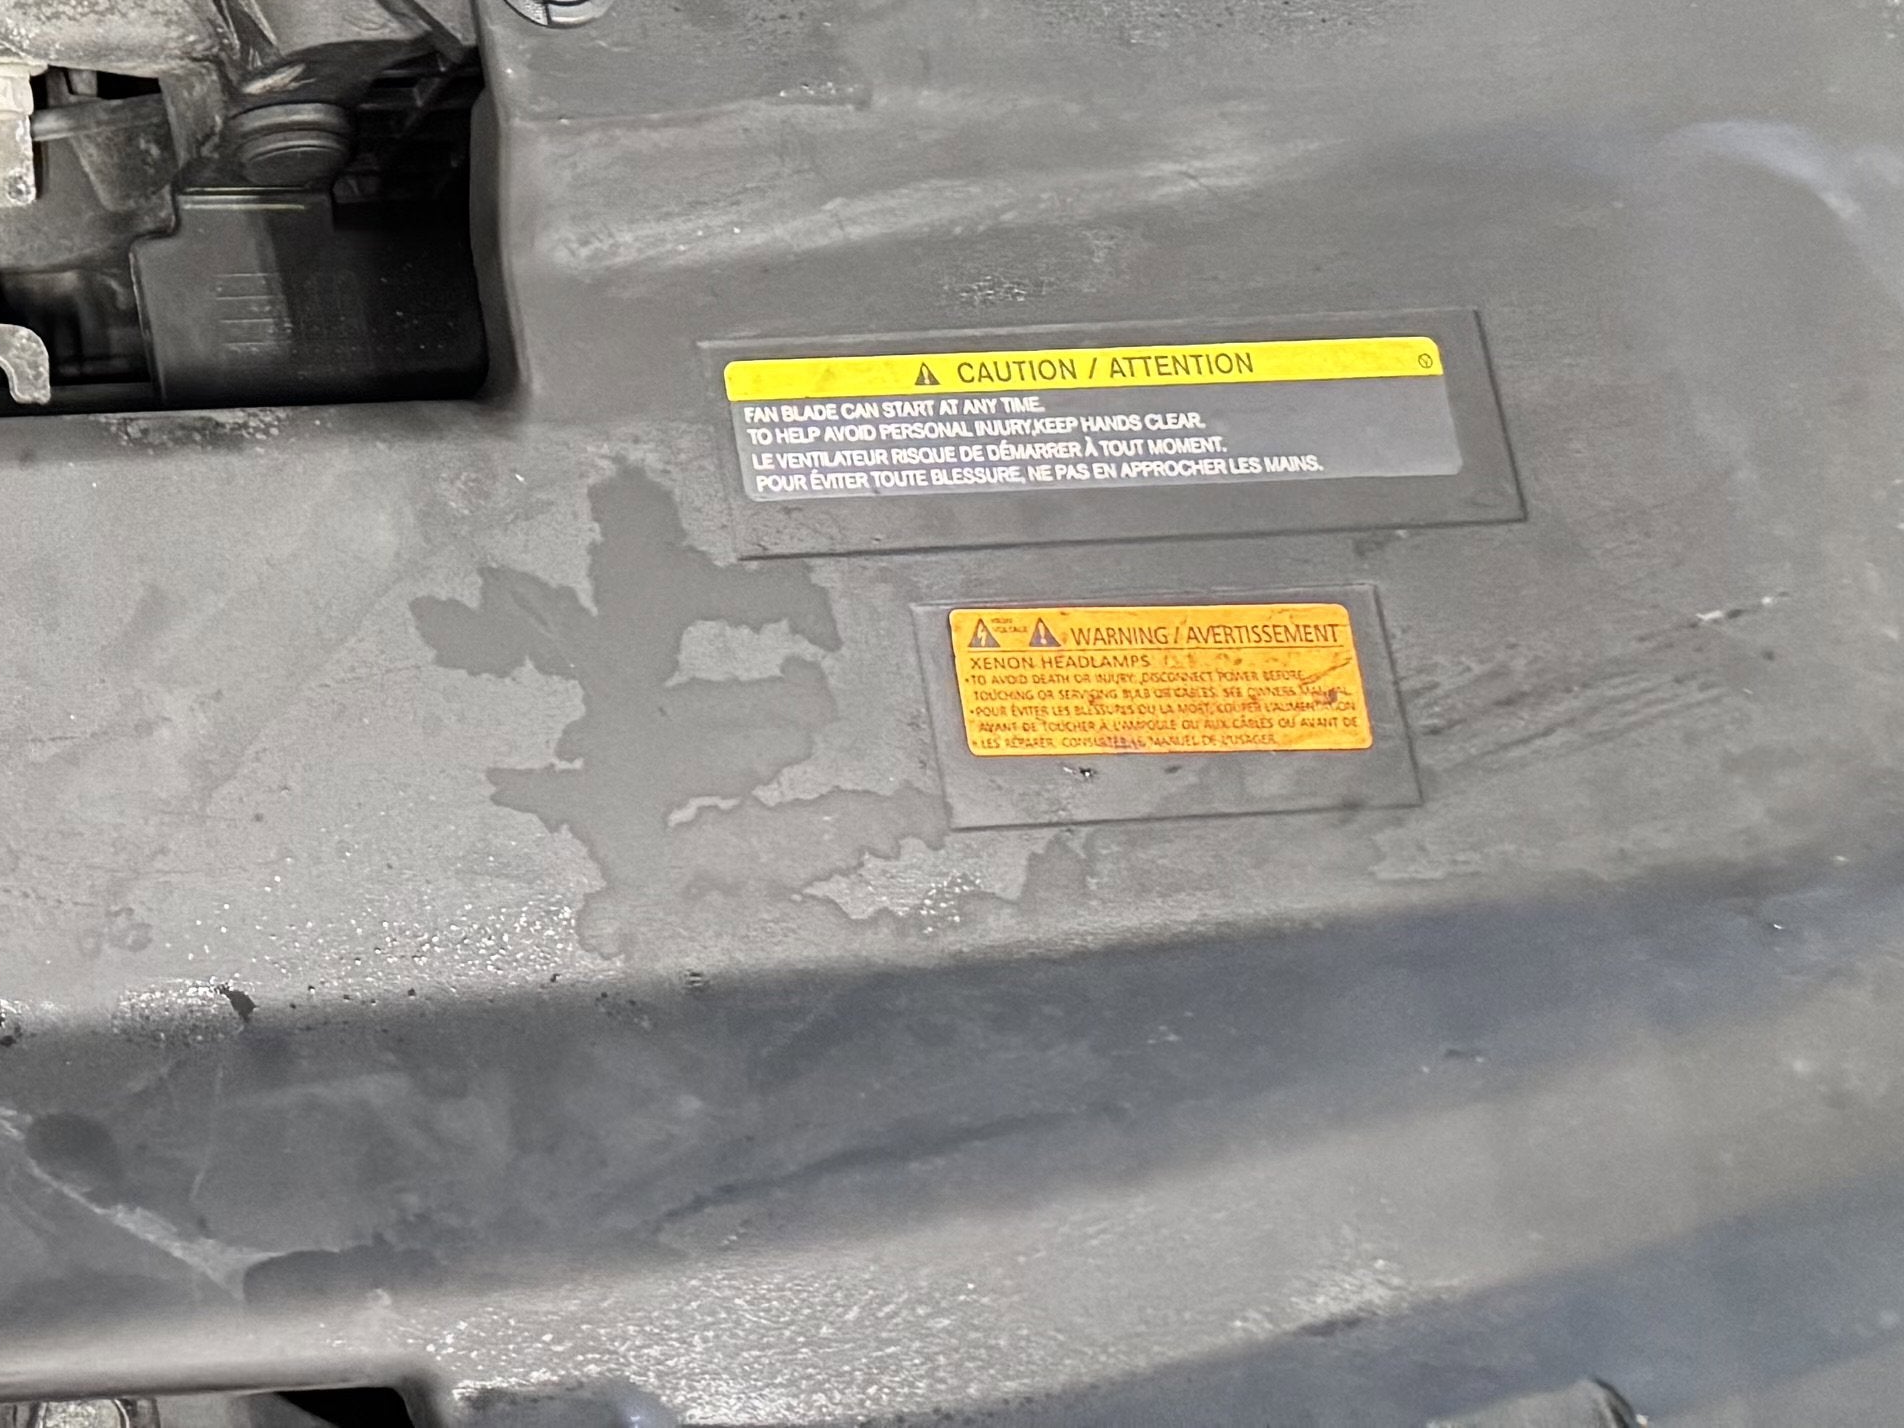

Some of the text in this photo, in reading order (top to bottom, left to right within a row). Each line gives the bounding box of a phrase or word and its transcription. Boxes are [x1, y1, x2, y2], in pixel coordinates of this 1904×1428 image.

[957, 352, 1254, 382] CAUTION / ATTENTION
[744, 396, 1045, 423] FAN BLADE CAN START AT ANY TIME.
[747, 429, 773, 444] TO
[776, 427, 820, 443] HELP
[824, 425, 877, 442] AVOID
[880, 421, 974, 439] PERSONAL
[1080, 415, 1142, 432] HANDS
[1144, 412, 1206, 430] CLEAR.
[752, 435, 1228, 470] LE VENTILATEUR RISQUE DE DÉMARRER À TOUT MOMENT.
[756, 455, 1324, 492] POUR ÉVITER TOUTE BLESSURE, NE PAS EN APPROCHER LES MAINS.
[1070, 627, 1168, 645] WARNING
[1186, 625, 1339, 644] AVERTISSEMENT
[970, 655, 1150, 670] XENON HEADLAMPS
[992, 675, 1028, 685] AVOID
[1032, 674, 1070, 684] DEATH
[1074, 674, 1090, 684] OR
[1263, 670, 1302, 680] BEFORE
[974, 690, 1034, 701] TOUCHING
[1038, 690, 1056, 700] OR
[976, 706, 1007, 716] POUR
[1052, 705, 1070, 715] LES
